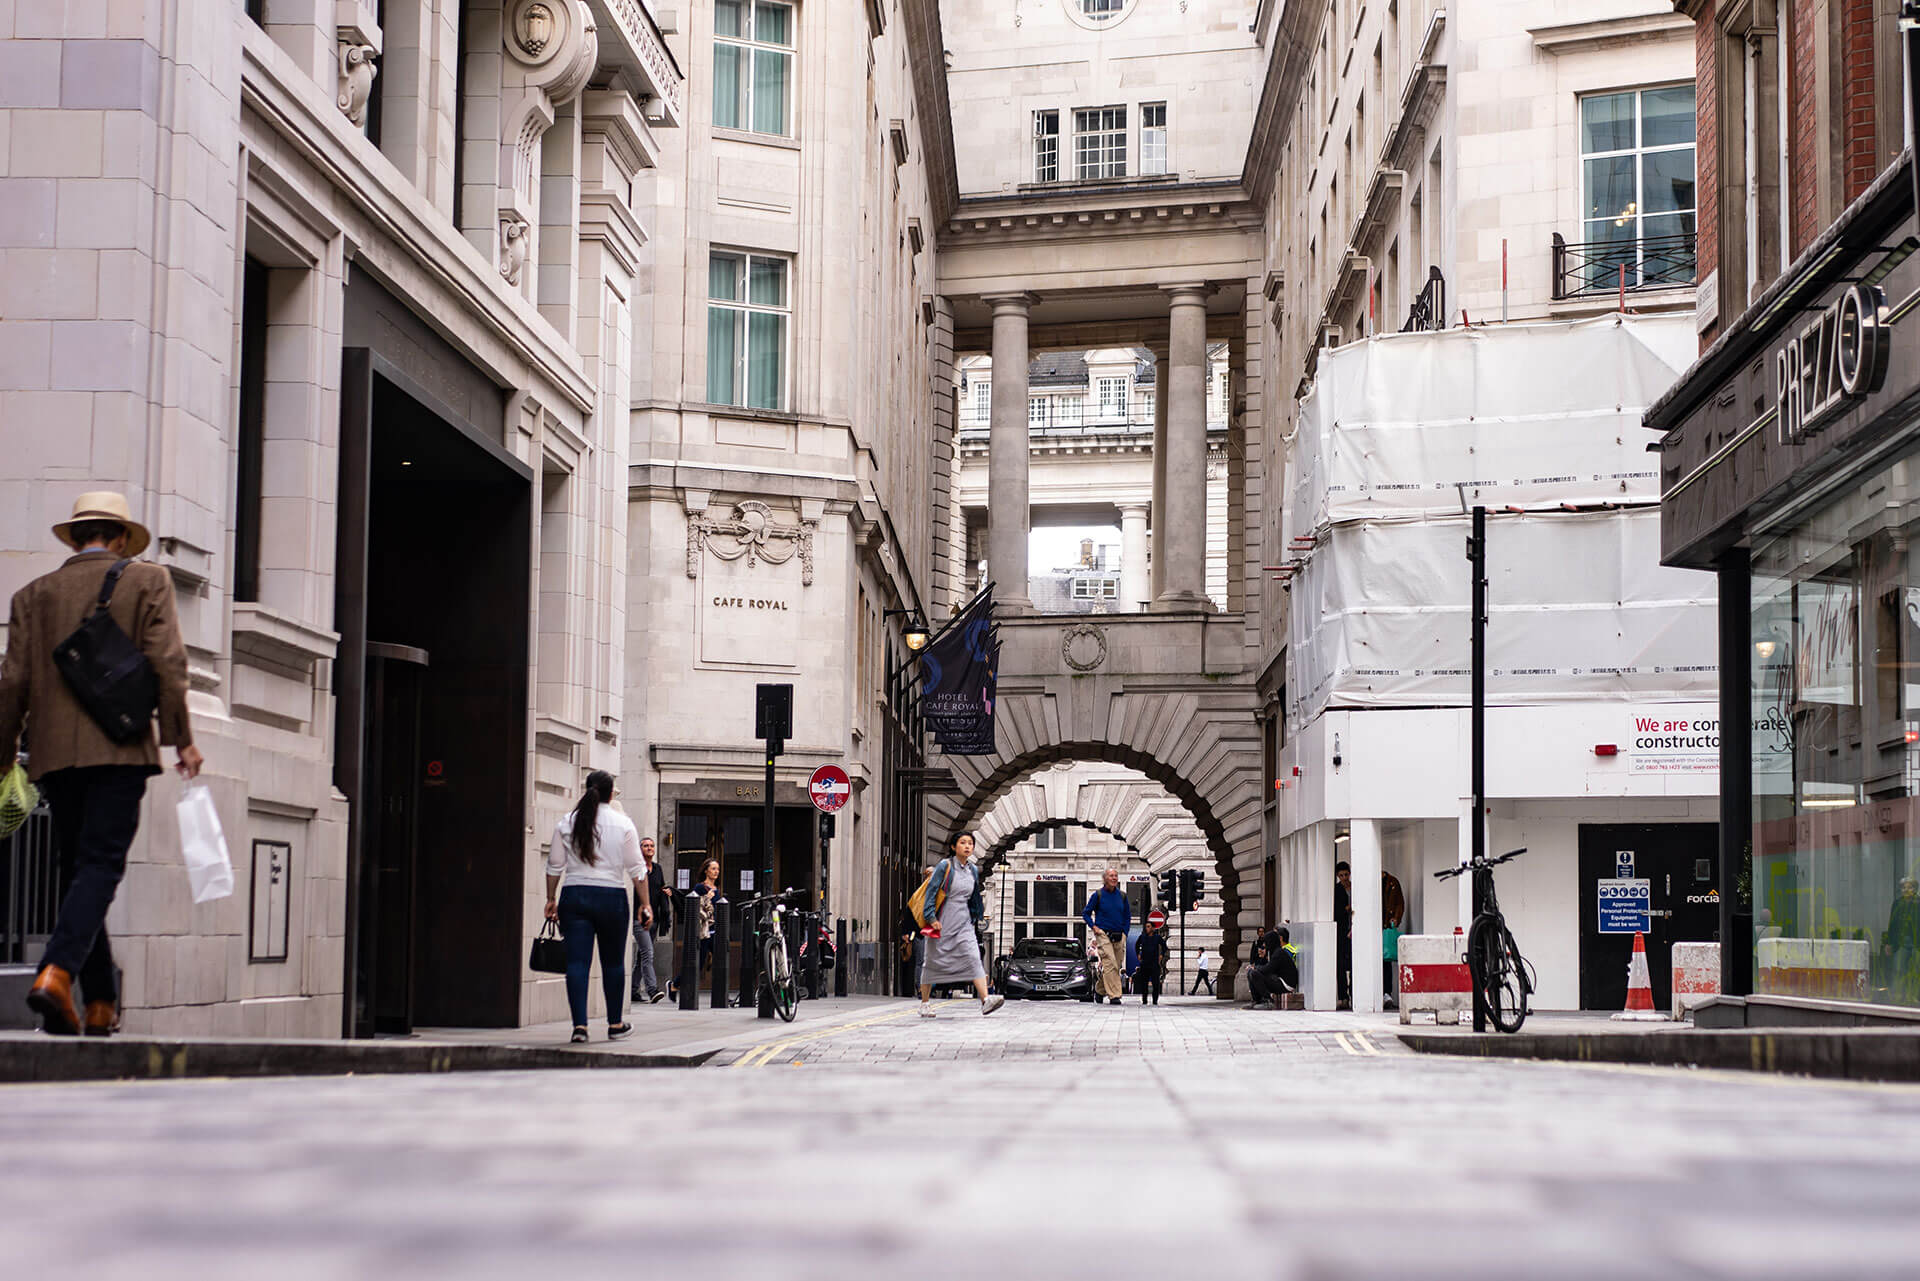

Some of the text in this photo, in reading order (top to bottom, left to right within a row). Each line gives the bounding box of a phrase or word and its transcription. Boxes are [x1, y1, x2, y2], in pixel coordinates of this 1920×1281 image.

[713, 597, 788, 611] CAFE ROYAL
[937, 693, 968, 701] HOTEL
[1635, 717, 1660, 732] We
[1663, 720, 1689, 732] are
[736, 786, 760, 796] BAR
